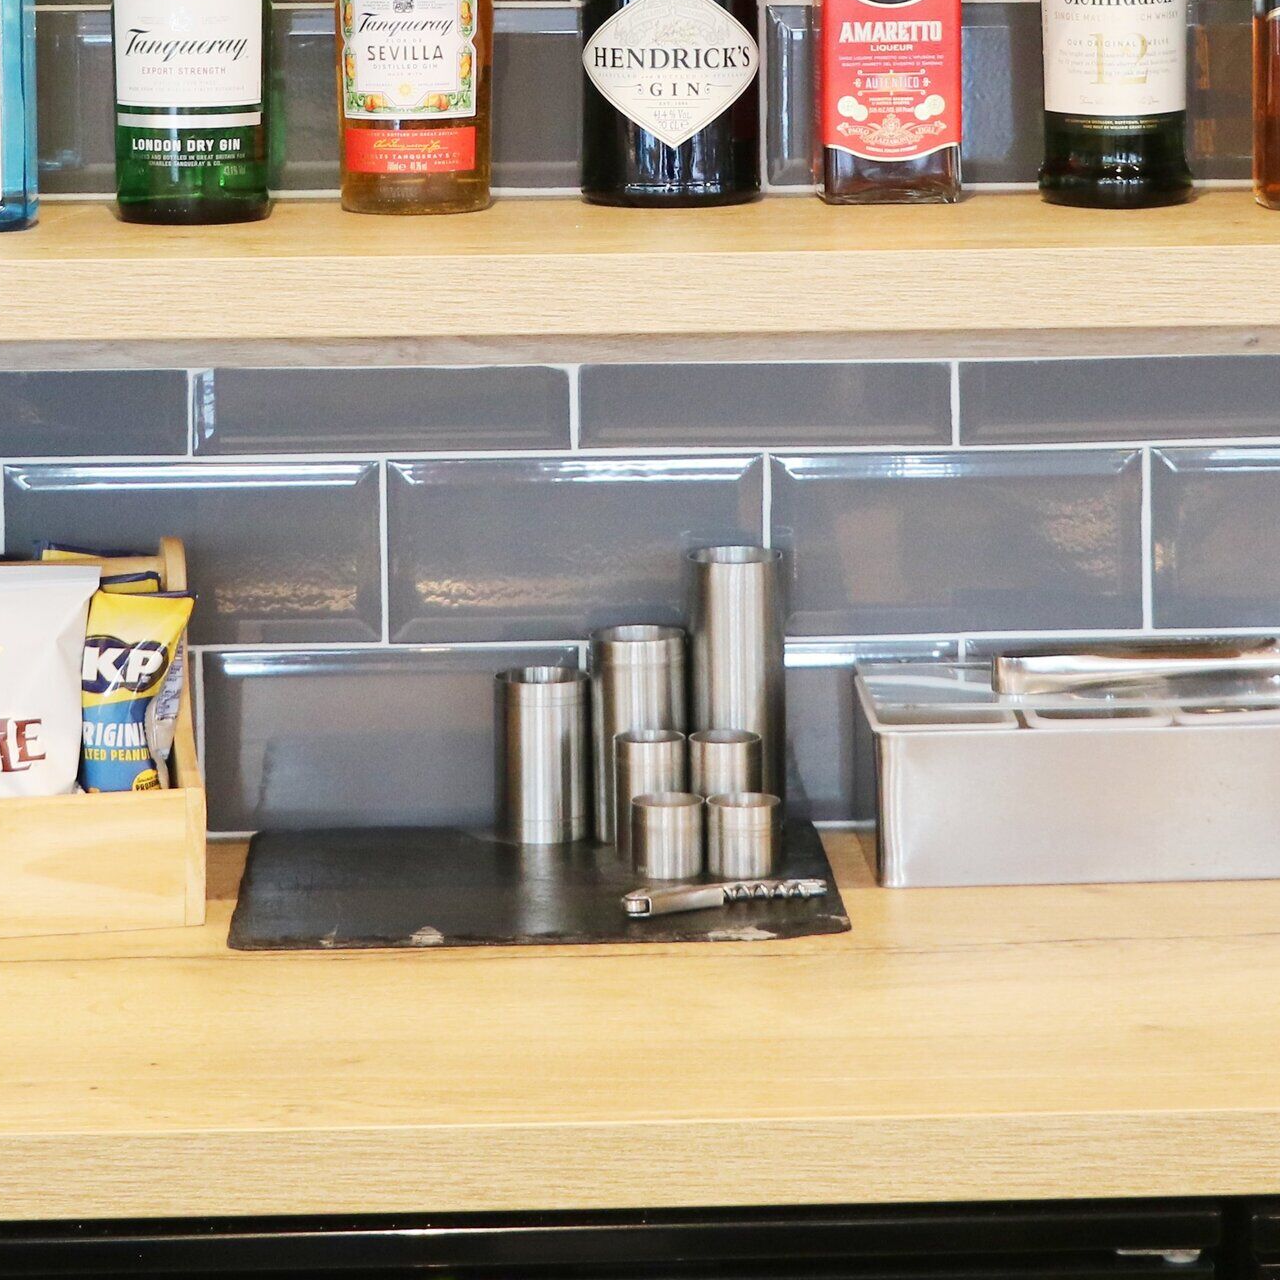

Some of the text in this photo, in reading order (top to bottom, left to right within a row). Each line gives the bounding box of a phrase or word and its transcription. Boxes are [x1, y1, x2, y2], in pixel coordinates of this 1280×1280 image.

[357, 12, 456, 39] Tanqueray
[838, 20, 943, 43] AMARETTO
[124, 28, 248, 63] Tanqueray
[366, 45, 444, 61] SEVILLA
[870, 43, 914, 52] LIQUEUR
[593, 45, 751, 70] HENDRICK'S
[141, 66, 227, 76] EXPORT STRENGTH
[649, 81, 701, 97] GIN
[865, 76, 920, 89] AUTENTICO
[132, 138, 241, 152] LONDON DRY GIN
[82, 645, 166, 684] KP
[83, 721, 147, 747] RIGIN
